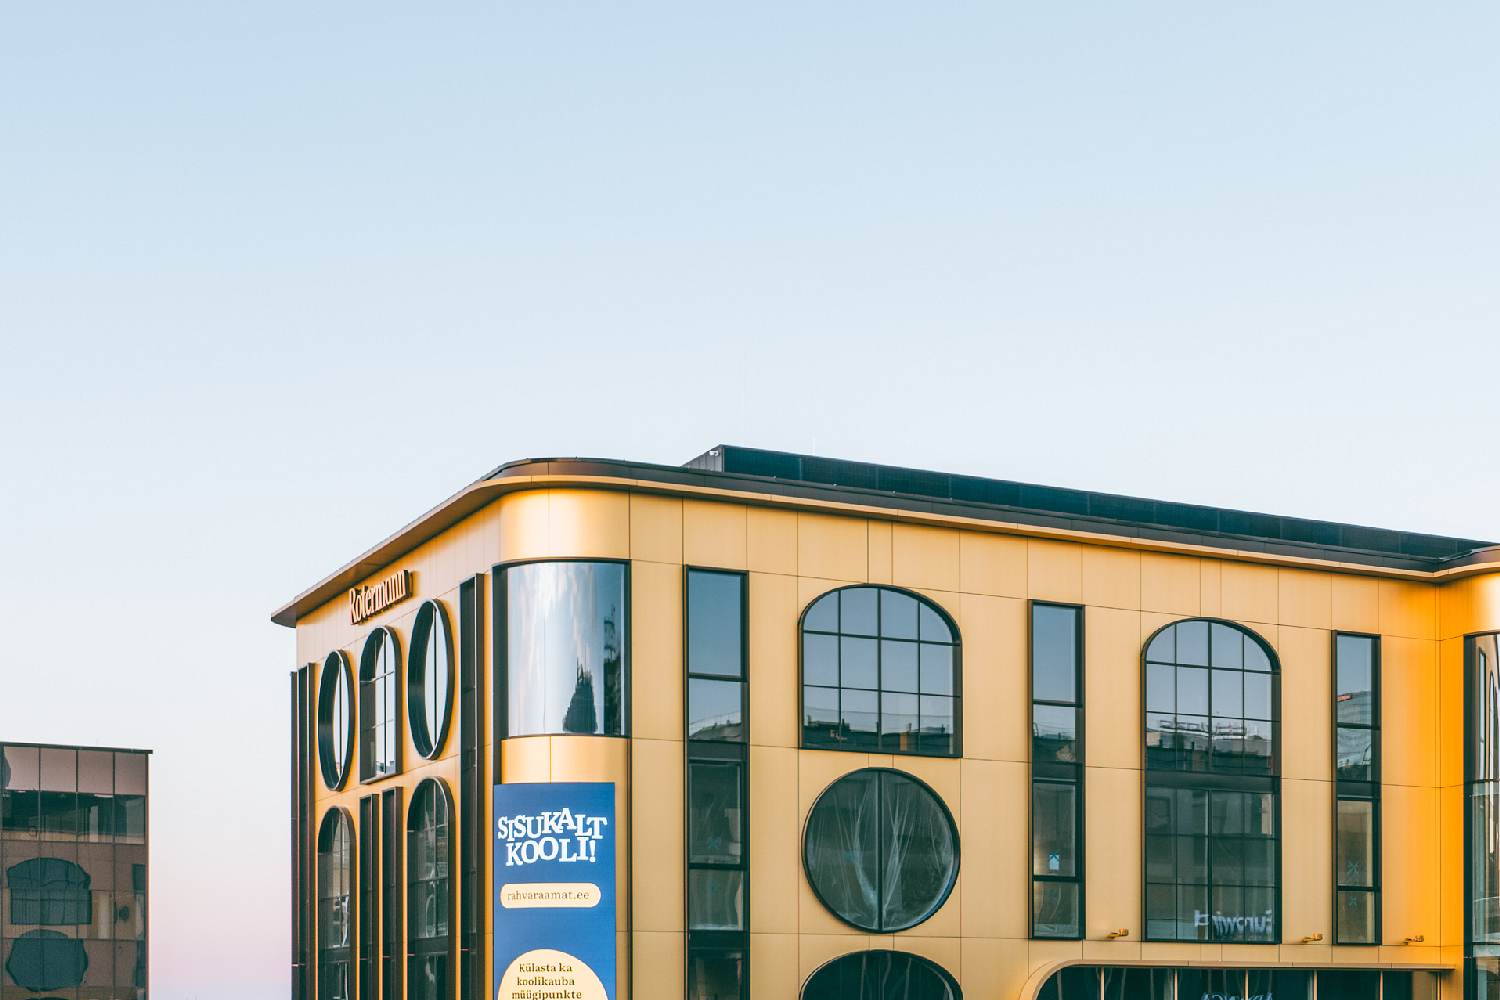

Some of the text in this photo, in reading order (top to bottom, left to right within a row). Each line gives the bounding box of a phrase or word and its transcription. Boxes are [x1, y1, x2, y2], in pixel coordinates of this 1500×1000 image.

[349, 569, 409, 625] Rotermann
[497, 807, 608, 842] SISUKALT
[505, 836, 596, 866] KOOLI!
[507, 890, 590, 901] rahvaraamat.ee
[519, 963, 573, 972] Külasta ka
[511, 989, 582, 1000] müügipunkte
